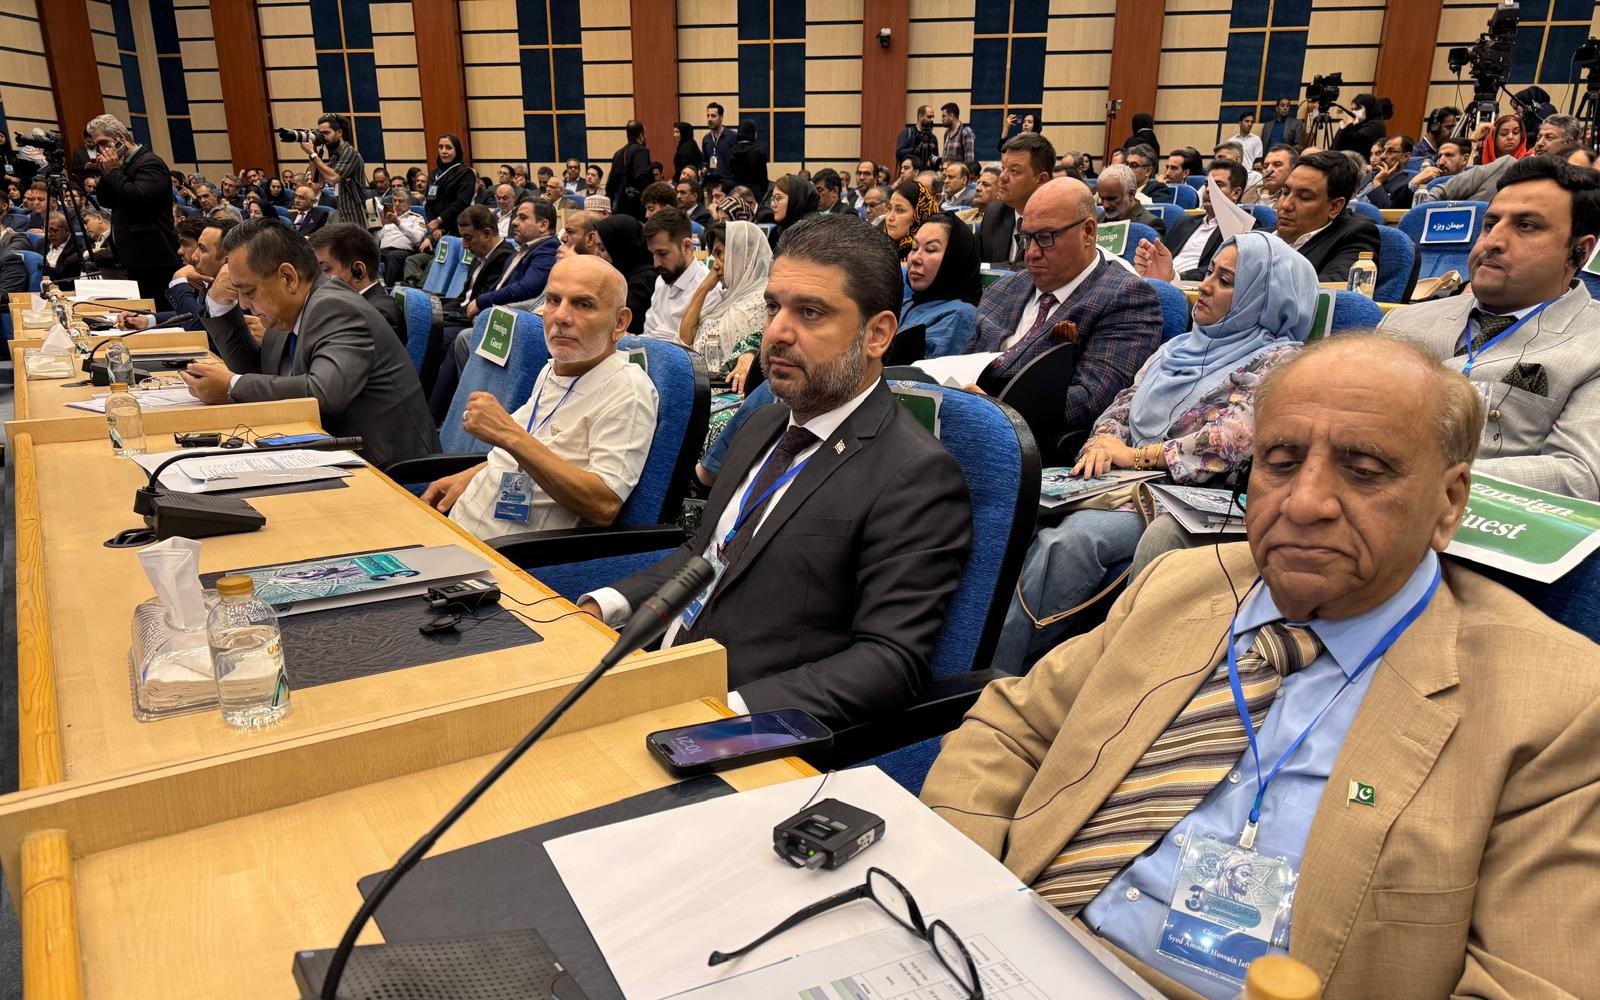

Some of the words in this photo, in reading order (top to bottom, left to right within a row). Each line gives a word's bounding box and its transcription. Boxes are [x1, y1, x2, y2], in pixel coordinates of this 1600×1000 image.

[1096, 232, 1118, 242] Foreign
[1471, 483, 1574, 516] Foreign
[1202, 928, 1225, 941] Guest
[1167, 934, 1184, 946] Syed
[1210, 948, 1238, 965] Hussain
